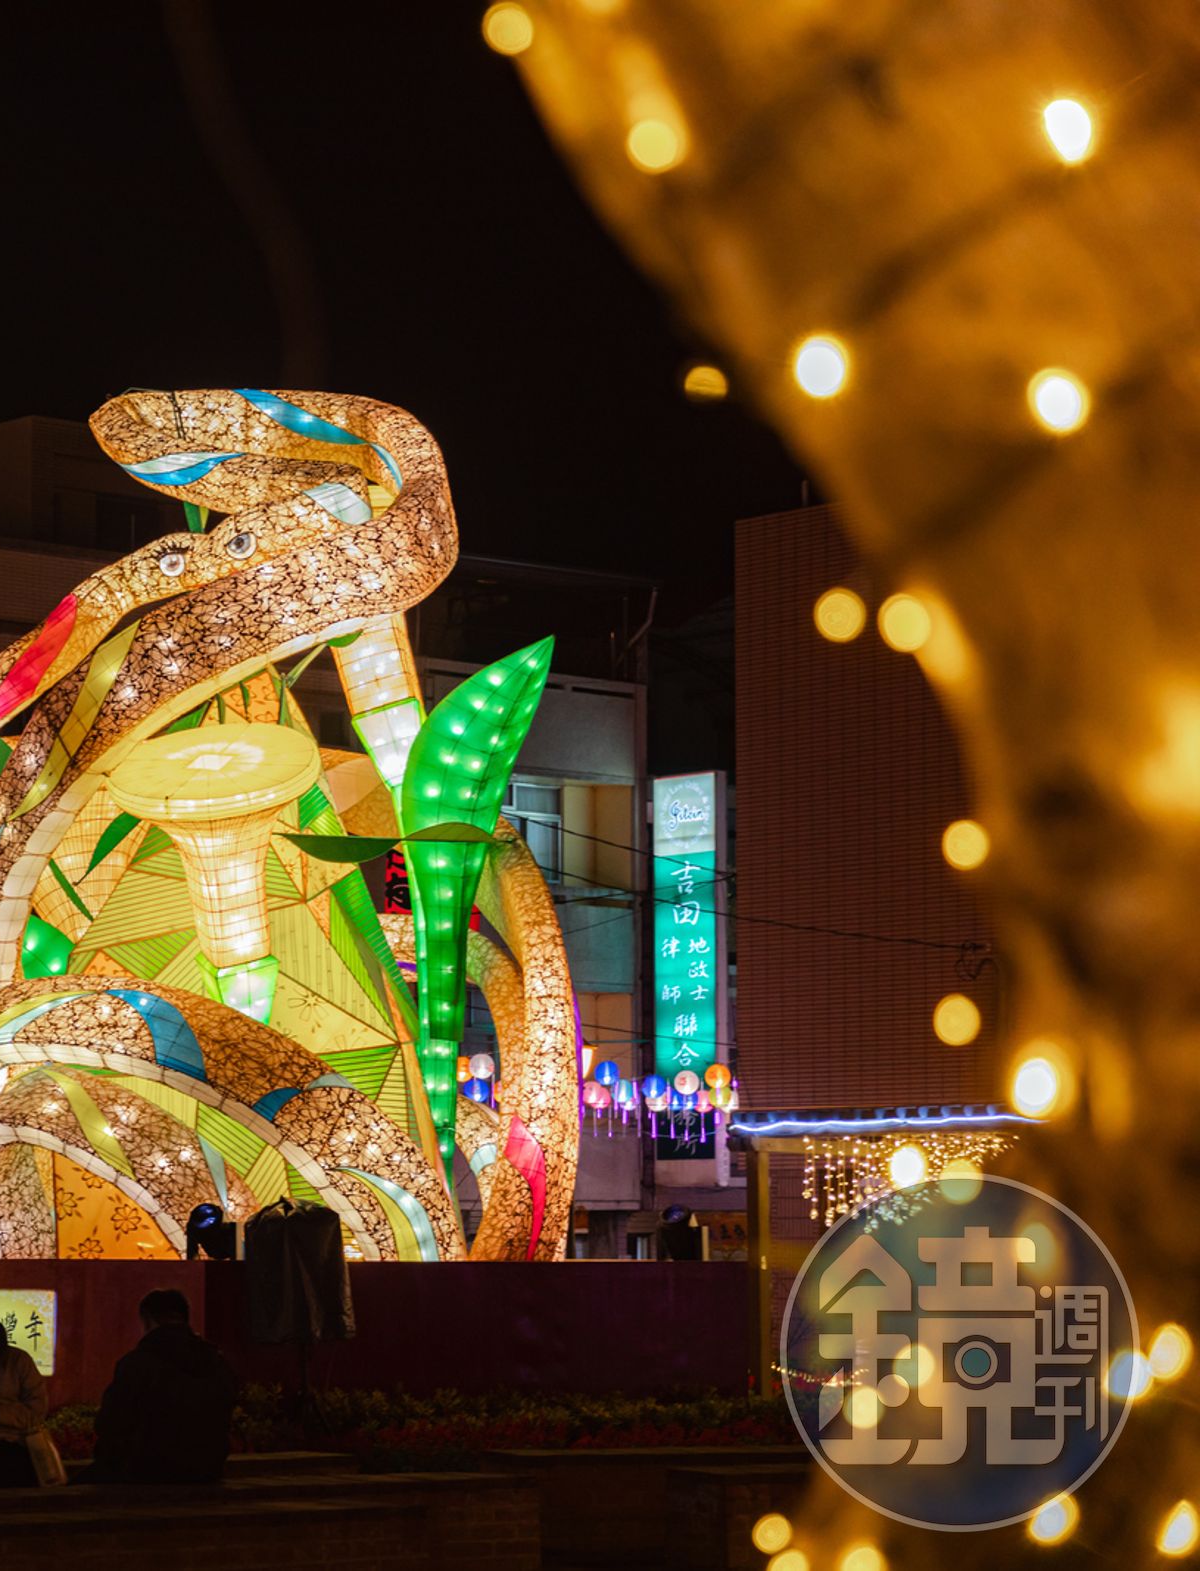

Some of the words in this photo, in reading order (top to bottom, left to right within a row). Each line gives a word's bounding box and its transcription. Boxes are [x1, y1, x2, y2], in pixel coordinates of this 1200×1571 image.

[661, 936, 681, 1005] 律師
[687, 936, 711, 1001] 地政士
